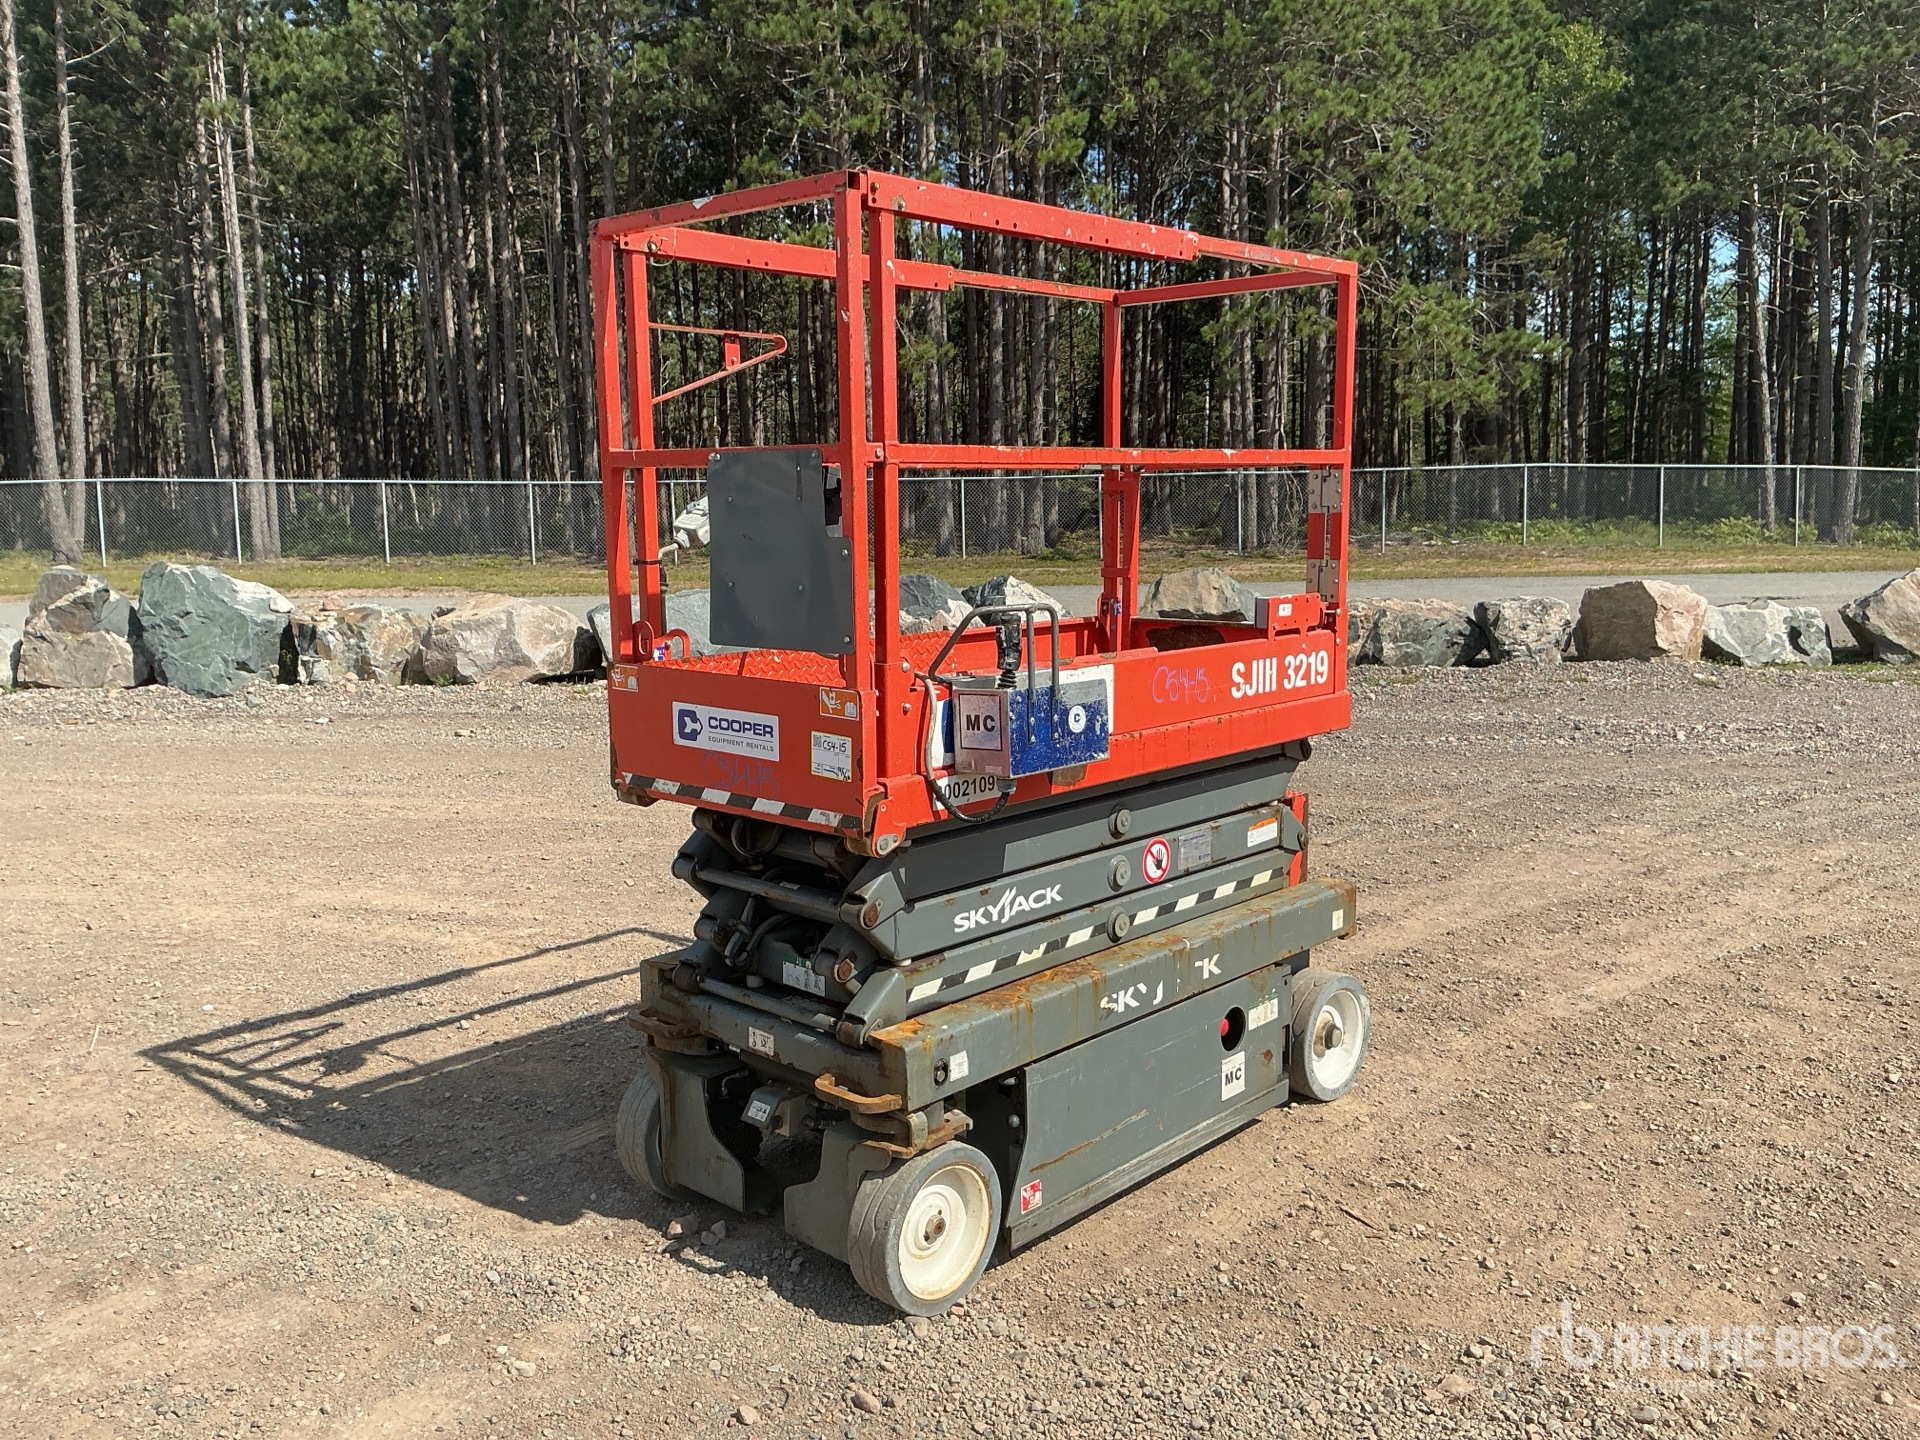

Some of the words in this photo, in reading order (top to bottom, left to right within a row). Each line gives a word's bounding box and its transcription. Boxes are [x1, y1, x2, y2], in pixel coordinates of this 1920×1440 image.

[1283, 650, 1329, 690] 3219
[708, 716, 774, 738] COOPER
[966, 714, 996, 732] MC
[708, 736, 744, 747] EQUIPMENT
[746, 743, 774, 752] RENTALS
[953, 884, 1064, 933] SKYJACK
[1224, 1067, 1242, 1086] MC
